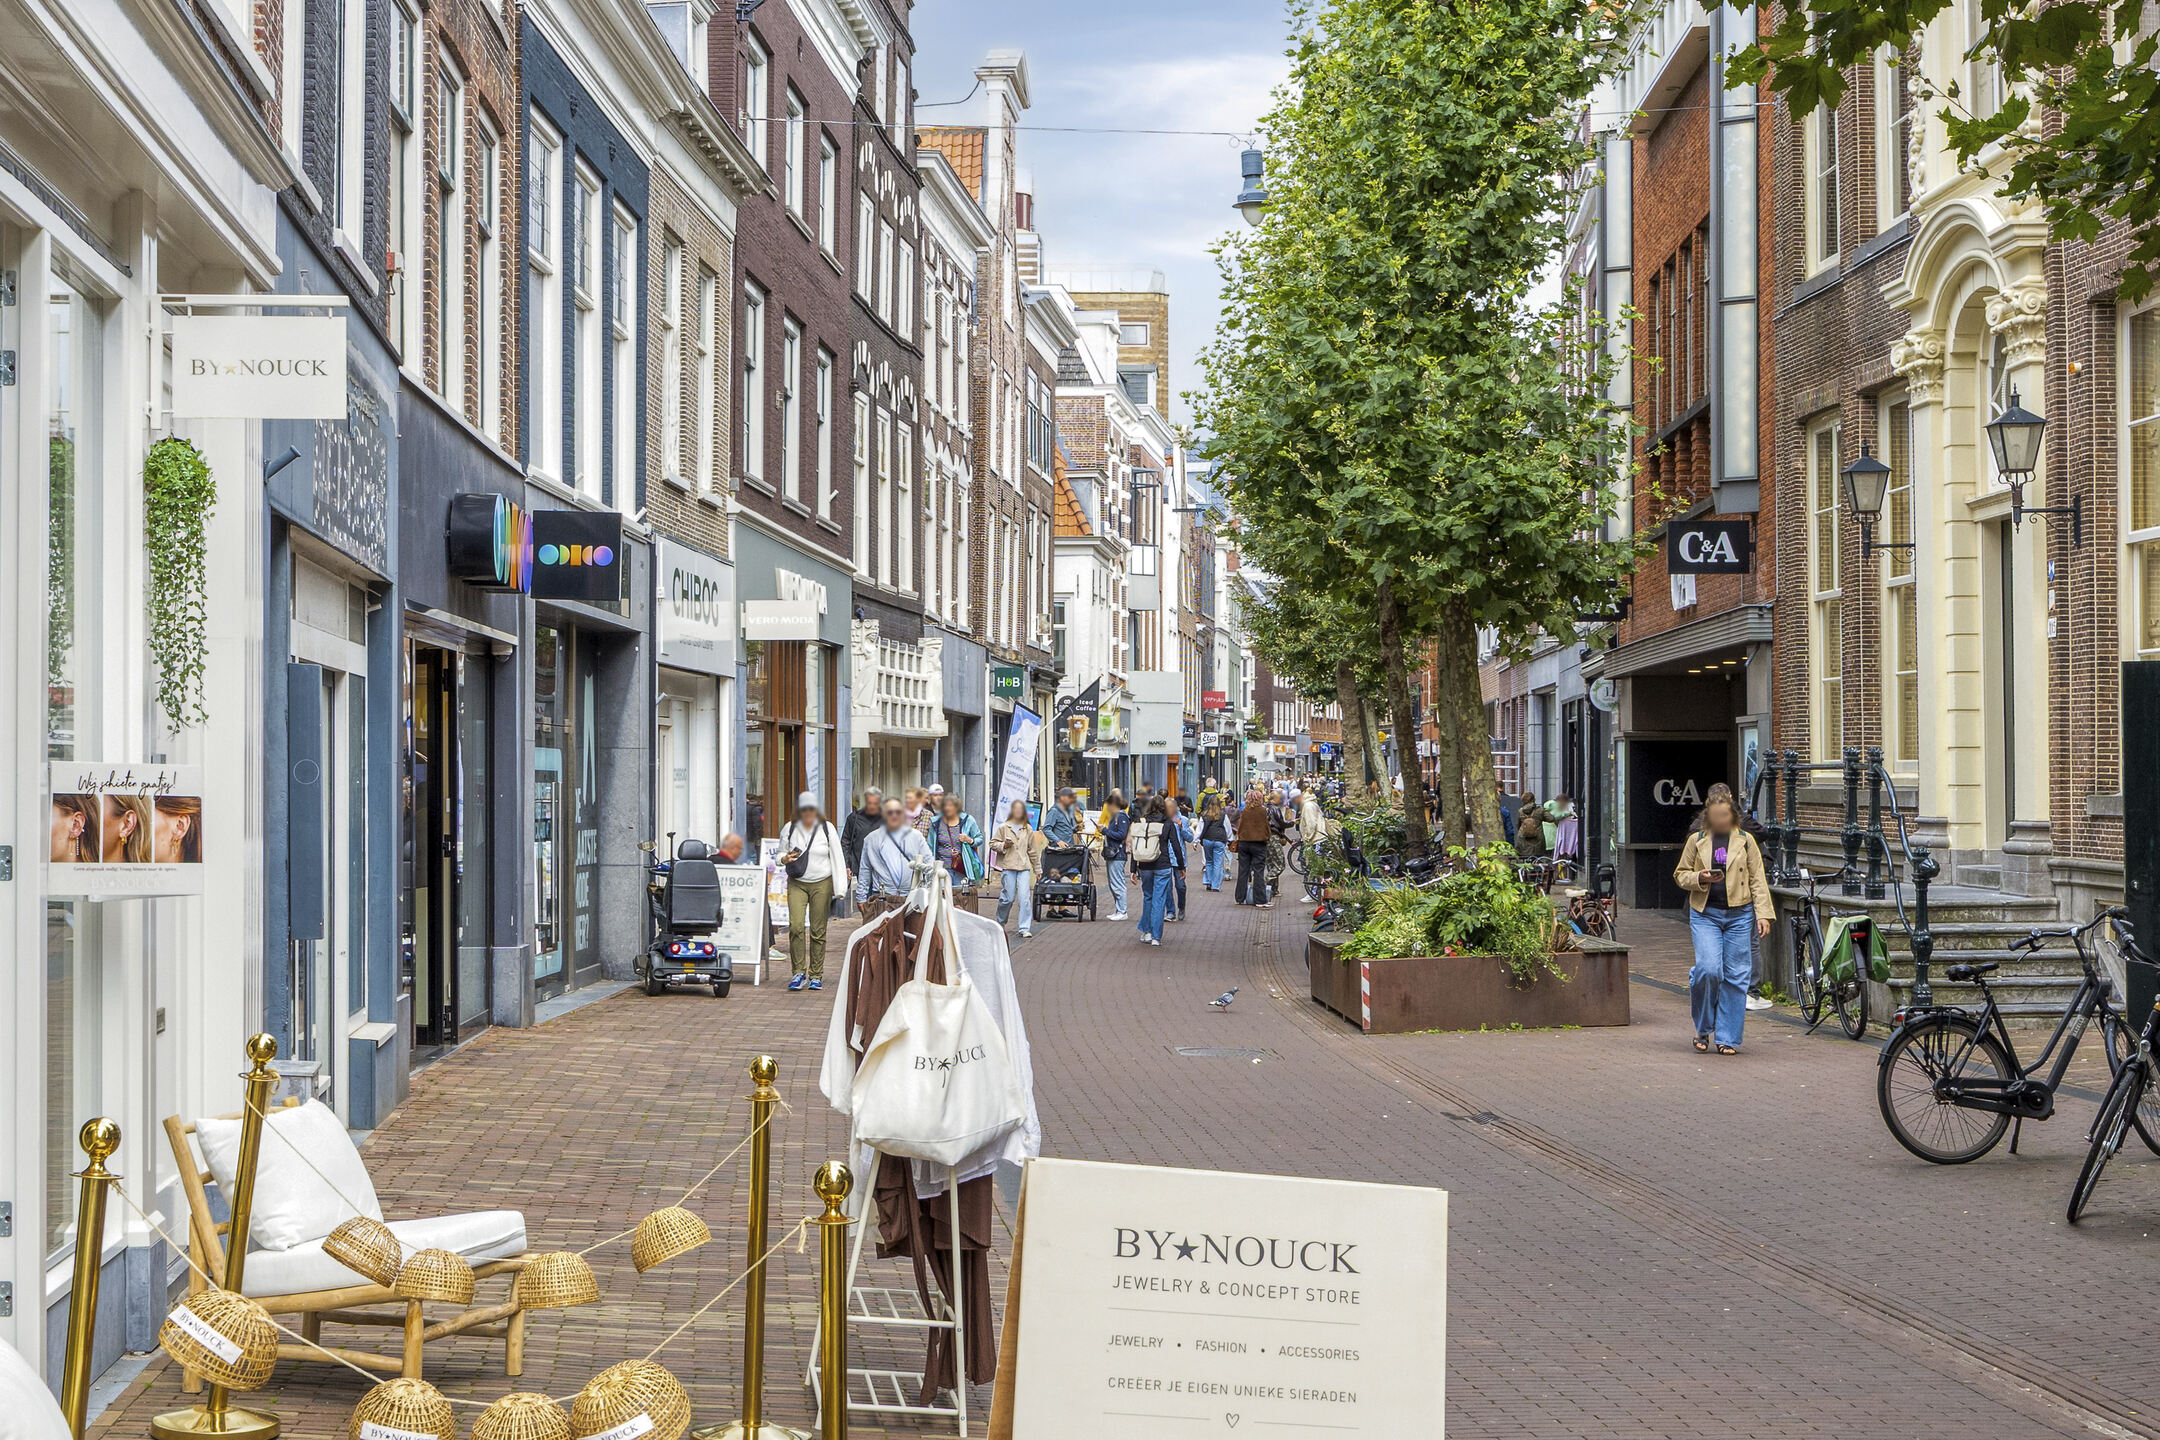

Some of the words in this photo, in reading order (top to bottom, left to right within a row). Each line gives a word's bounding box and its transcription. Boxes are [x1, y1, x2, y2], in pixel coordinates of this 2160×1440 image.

[190, 359, 221, 376] BY
[239, 359, 328, 376] NOUCK
[1678, 531, 1739, 563] C&A
[748, 616, 779, 625] VERO
[780, 616, 815, 625] MODA
[1202, 733, 1217, 742] Etos
[99, 770, 138, 792] schieten
[1653, 779, 1703, 805] C&A
[914, 1055, 938, 1071] BY
[1113, 1227, 1176, 1261] BY
[1200, 1233, 1361, 1274] NOUCK
[1112, 1275, 1194, 1294] JEWELRY
[1199, 1280, 1211, 1295] &
[1218, 1281, 1300, 1301] CONCEPT
[1305, 1288, 1361, 1305] STORE
[191, 1321, 226, 1350] NOUCK
[1107, 1335, 1164, 1348] JEWELRY
[1195, 1340, 1247, 1353] FASHION
[1278, 1345, 1360, 1361] ACCESSORIES
[1107, 1376, 1162, 1391] CREËER
[1167, 1381, 1182, 1393] JE
[1187, 1382, 1229, 1396] EIGEN
[1234, 1385, 1285, 1399] UNIEKE
[1289, 1388, 1357, 1403] SIERADEN
[370, 1428, 386, 1440] BY
